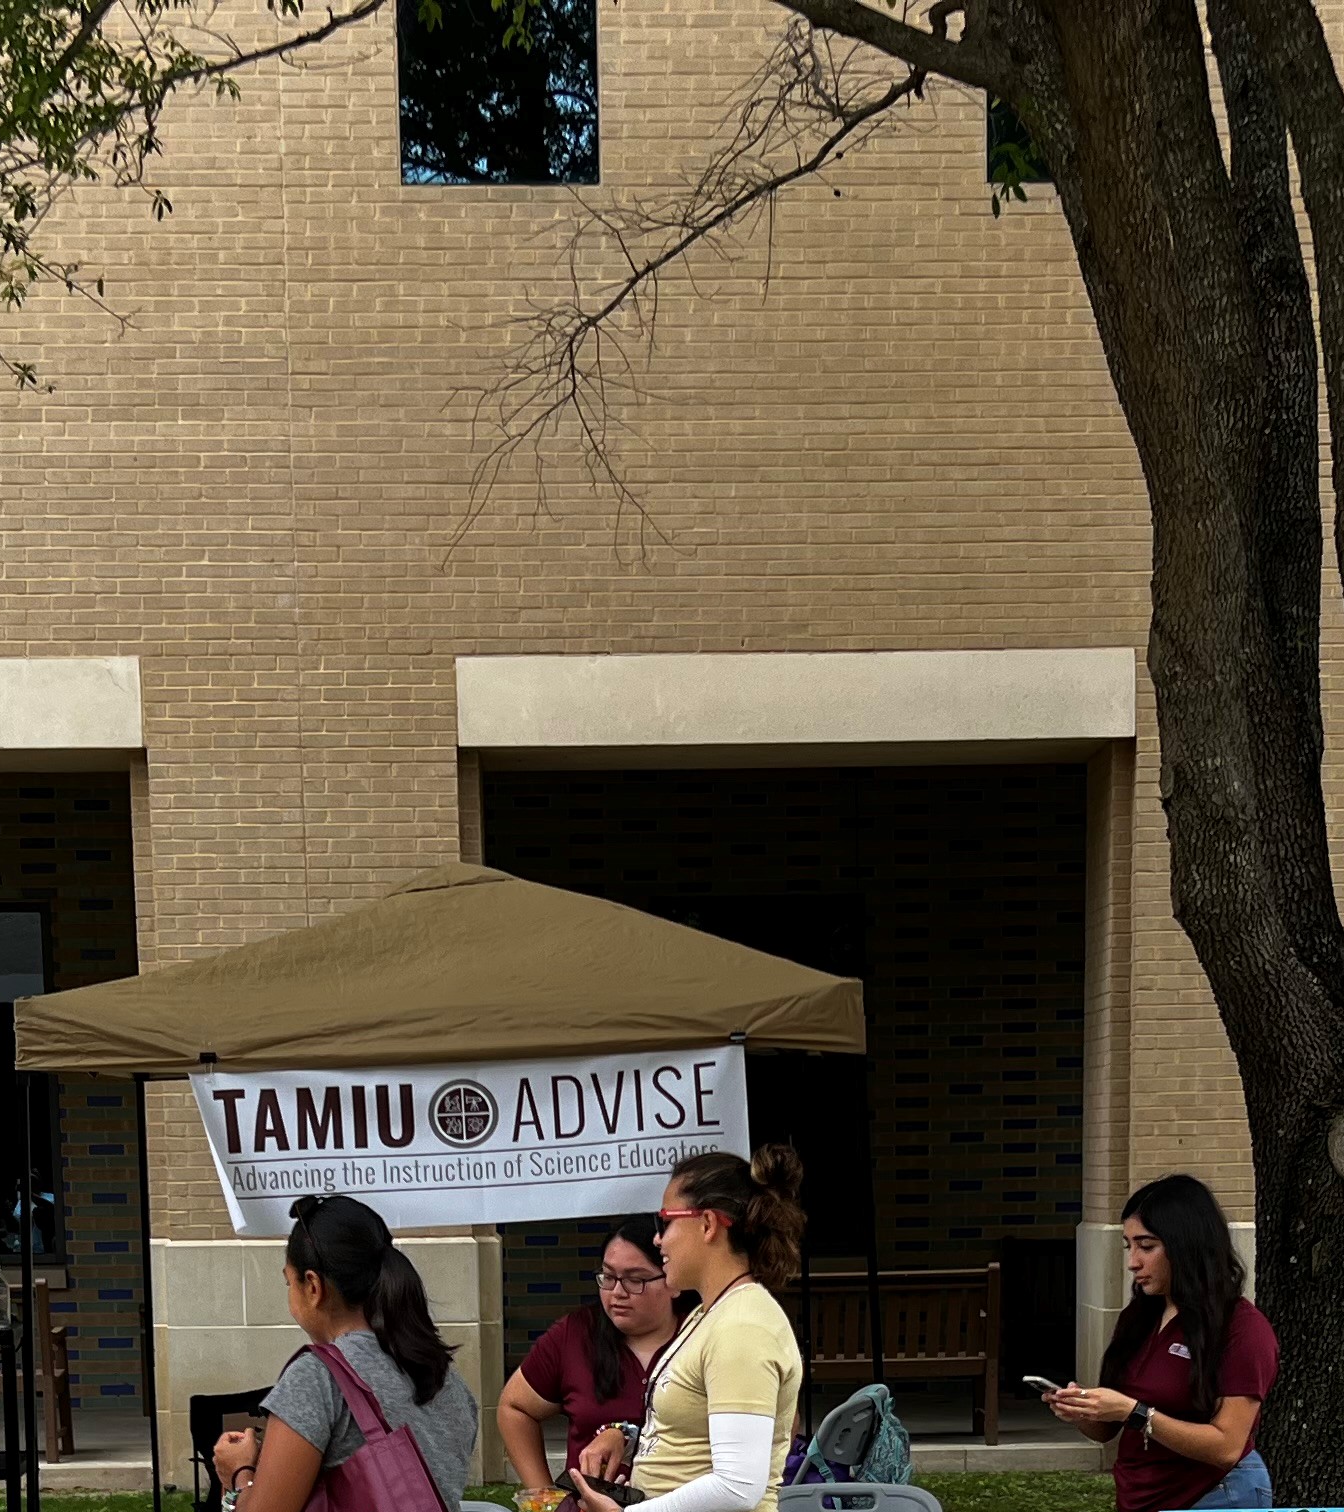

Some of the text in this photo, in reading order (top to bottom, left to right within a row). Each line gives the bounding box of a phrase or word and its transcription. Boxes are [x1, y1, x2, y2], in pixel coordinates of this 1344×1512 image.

[212, 1061, 721, 1154] TAMIU ADVISE
[232, 1163, 336, 1192] Advancing
[341, 1160, 376, 1187] the
[382, 1156, 496, 1184] Instruction
[503, 1152, 524, 1179] of
[529, 1147, 611, 1178] Science
